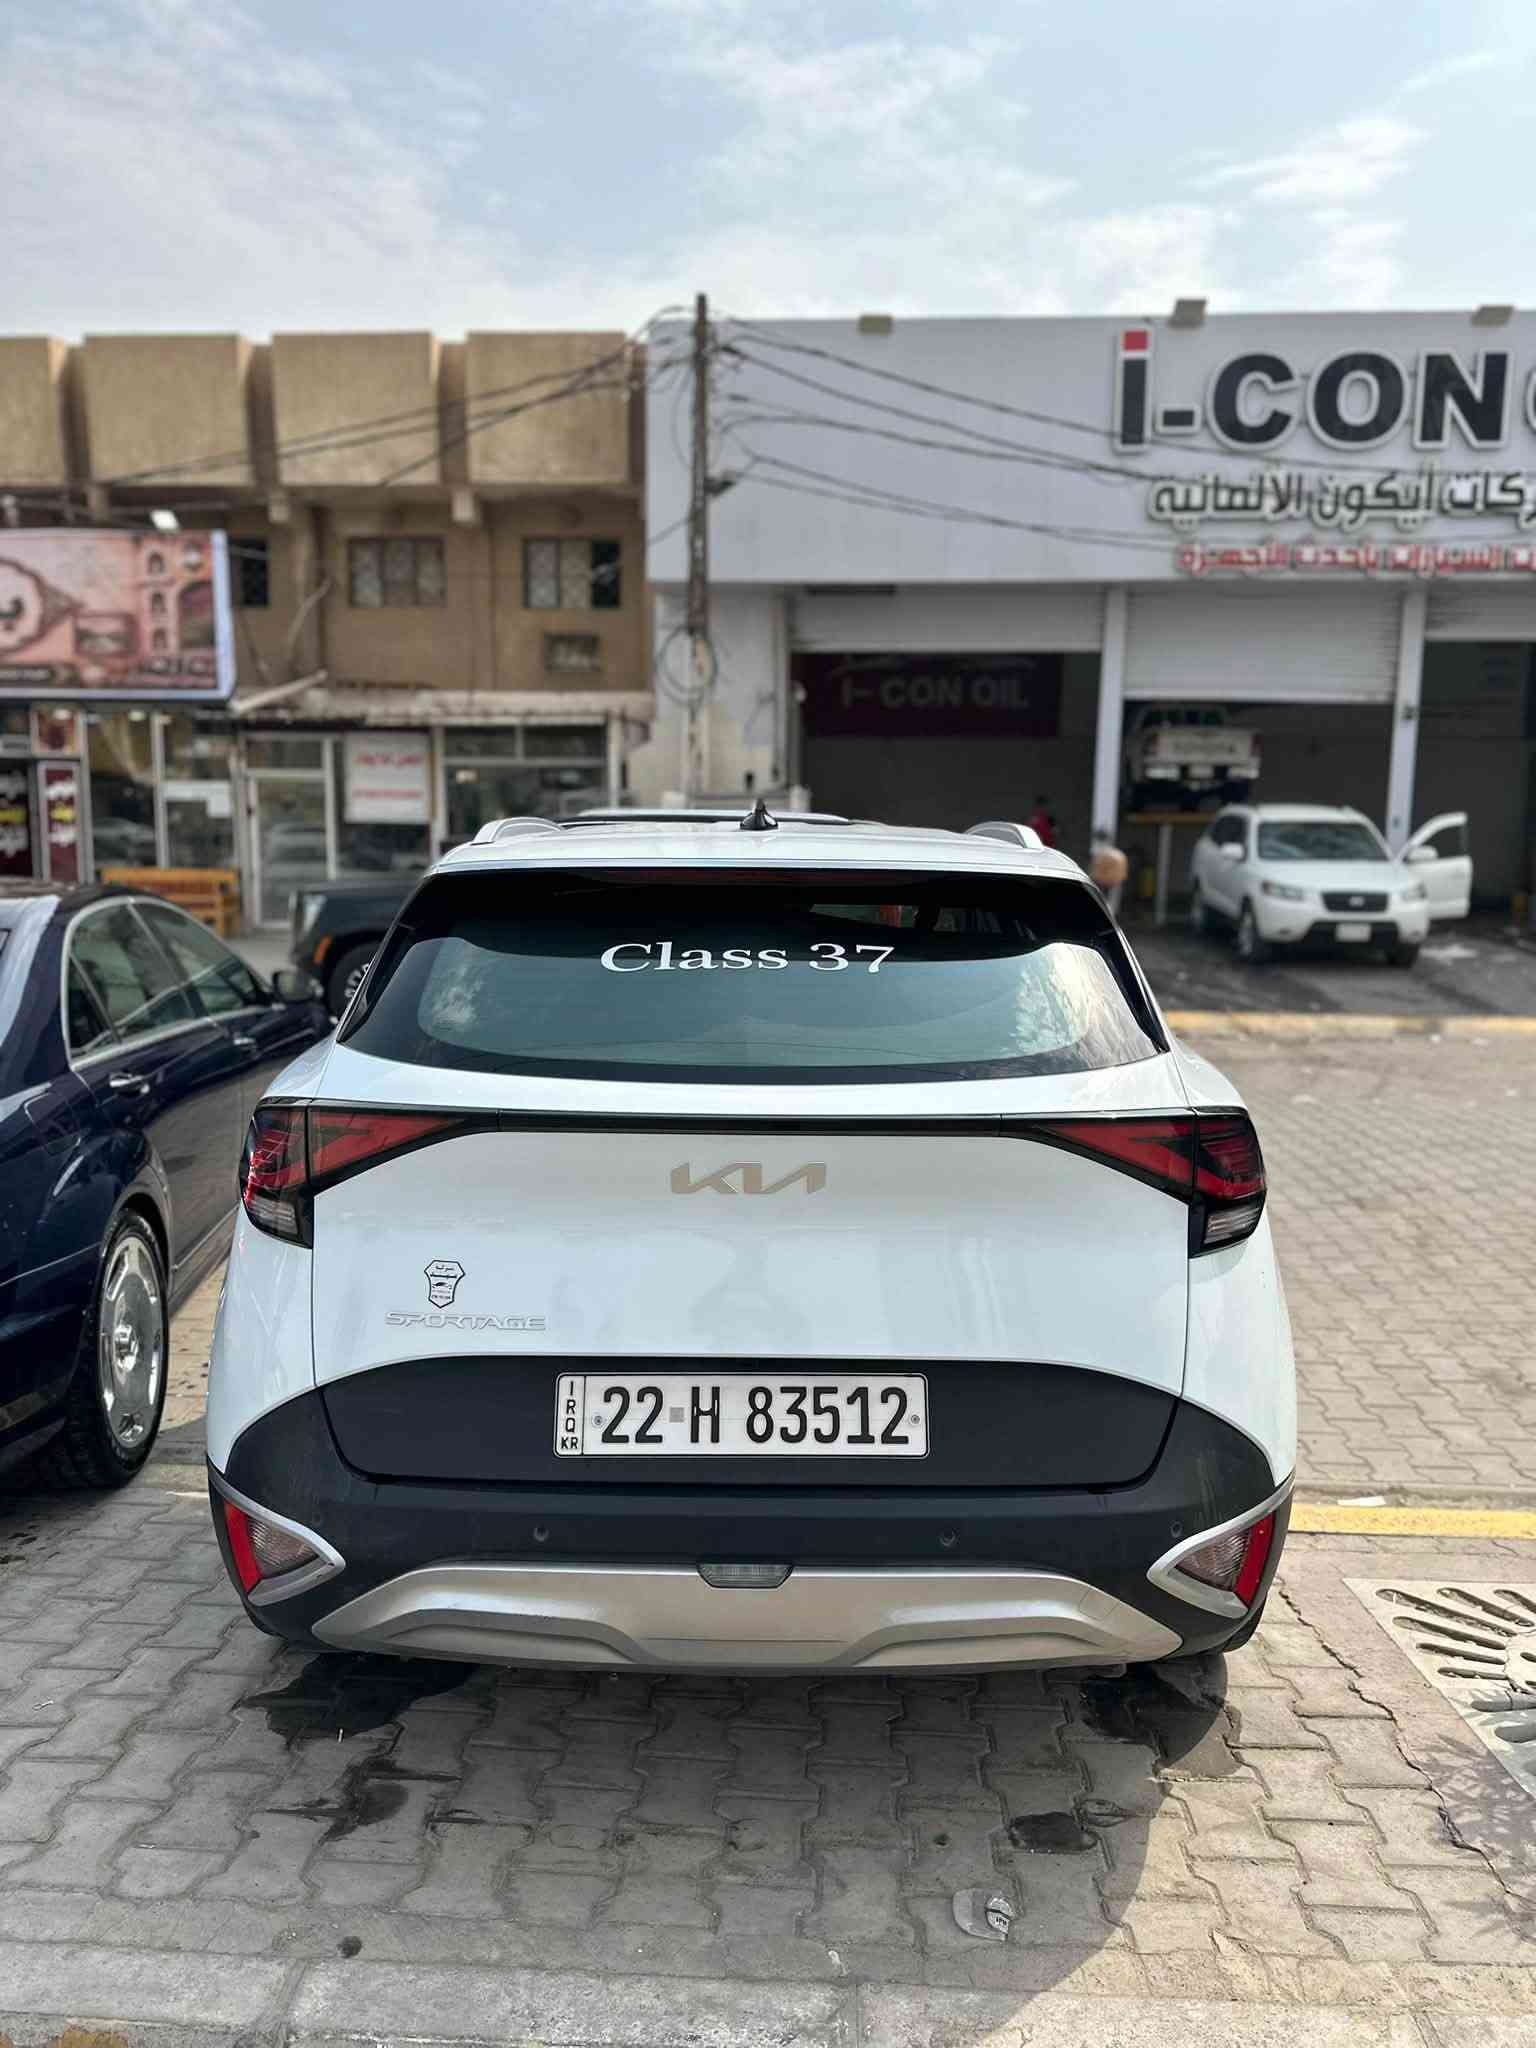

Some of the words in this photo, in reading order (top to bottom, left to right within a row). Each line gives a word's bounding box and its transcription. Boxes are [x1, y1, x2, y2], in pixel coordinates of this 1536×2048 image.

[1119, 330, 1508, 446] i-CON
[971, 674, 1030, 709] OIL
[599, 941, 789, 973] Class
[808, 943, 896, 973] 37
[670, 1160, 827, 1195] KIA
[384, 1311, 546, 1332] SPORTAGE
[600, 1385, 664, 1445] 22
[690, 1385, 721, 1444] H
[745, 1385, 910, 1445] 83512
[560, 1436, 579, 1450] KR
